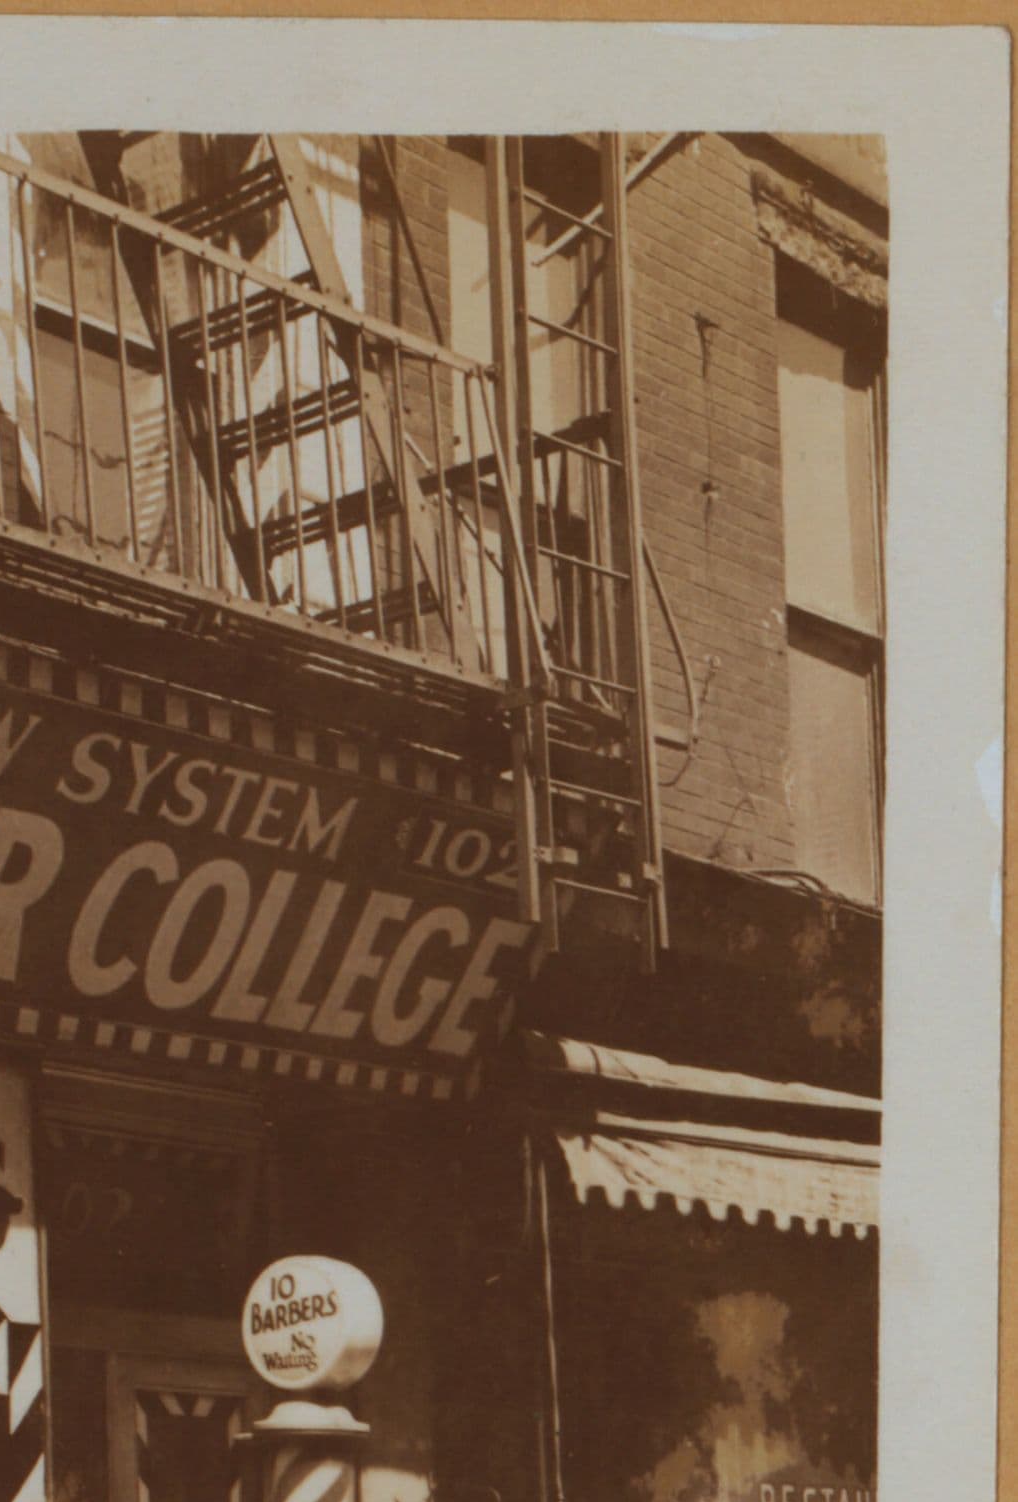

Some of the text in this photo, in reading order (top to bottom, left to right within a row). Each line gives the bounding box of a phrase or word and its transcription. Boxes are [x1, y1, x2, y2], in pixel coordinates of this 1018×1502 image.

[57, 732, 357, 861] SYSTEM
[68, 840, 535, 1056] COLLEGE
[251, 1289, 338, 1335] BARBERS
[270, 1273, 295, 1302] 10
